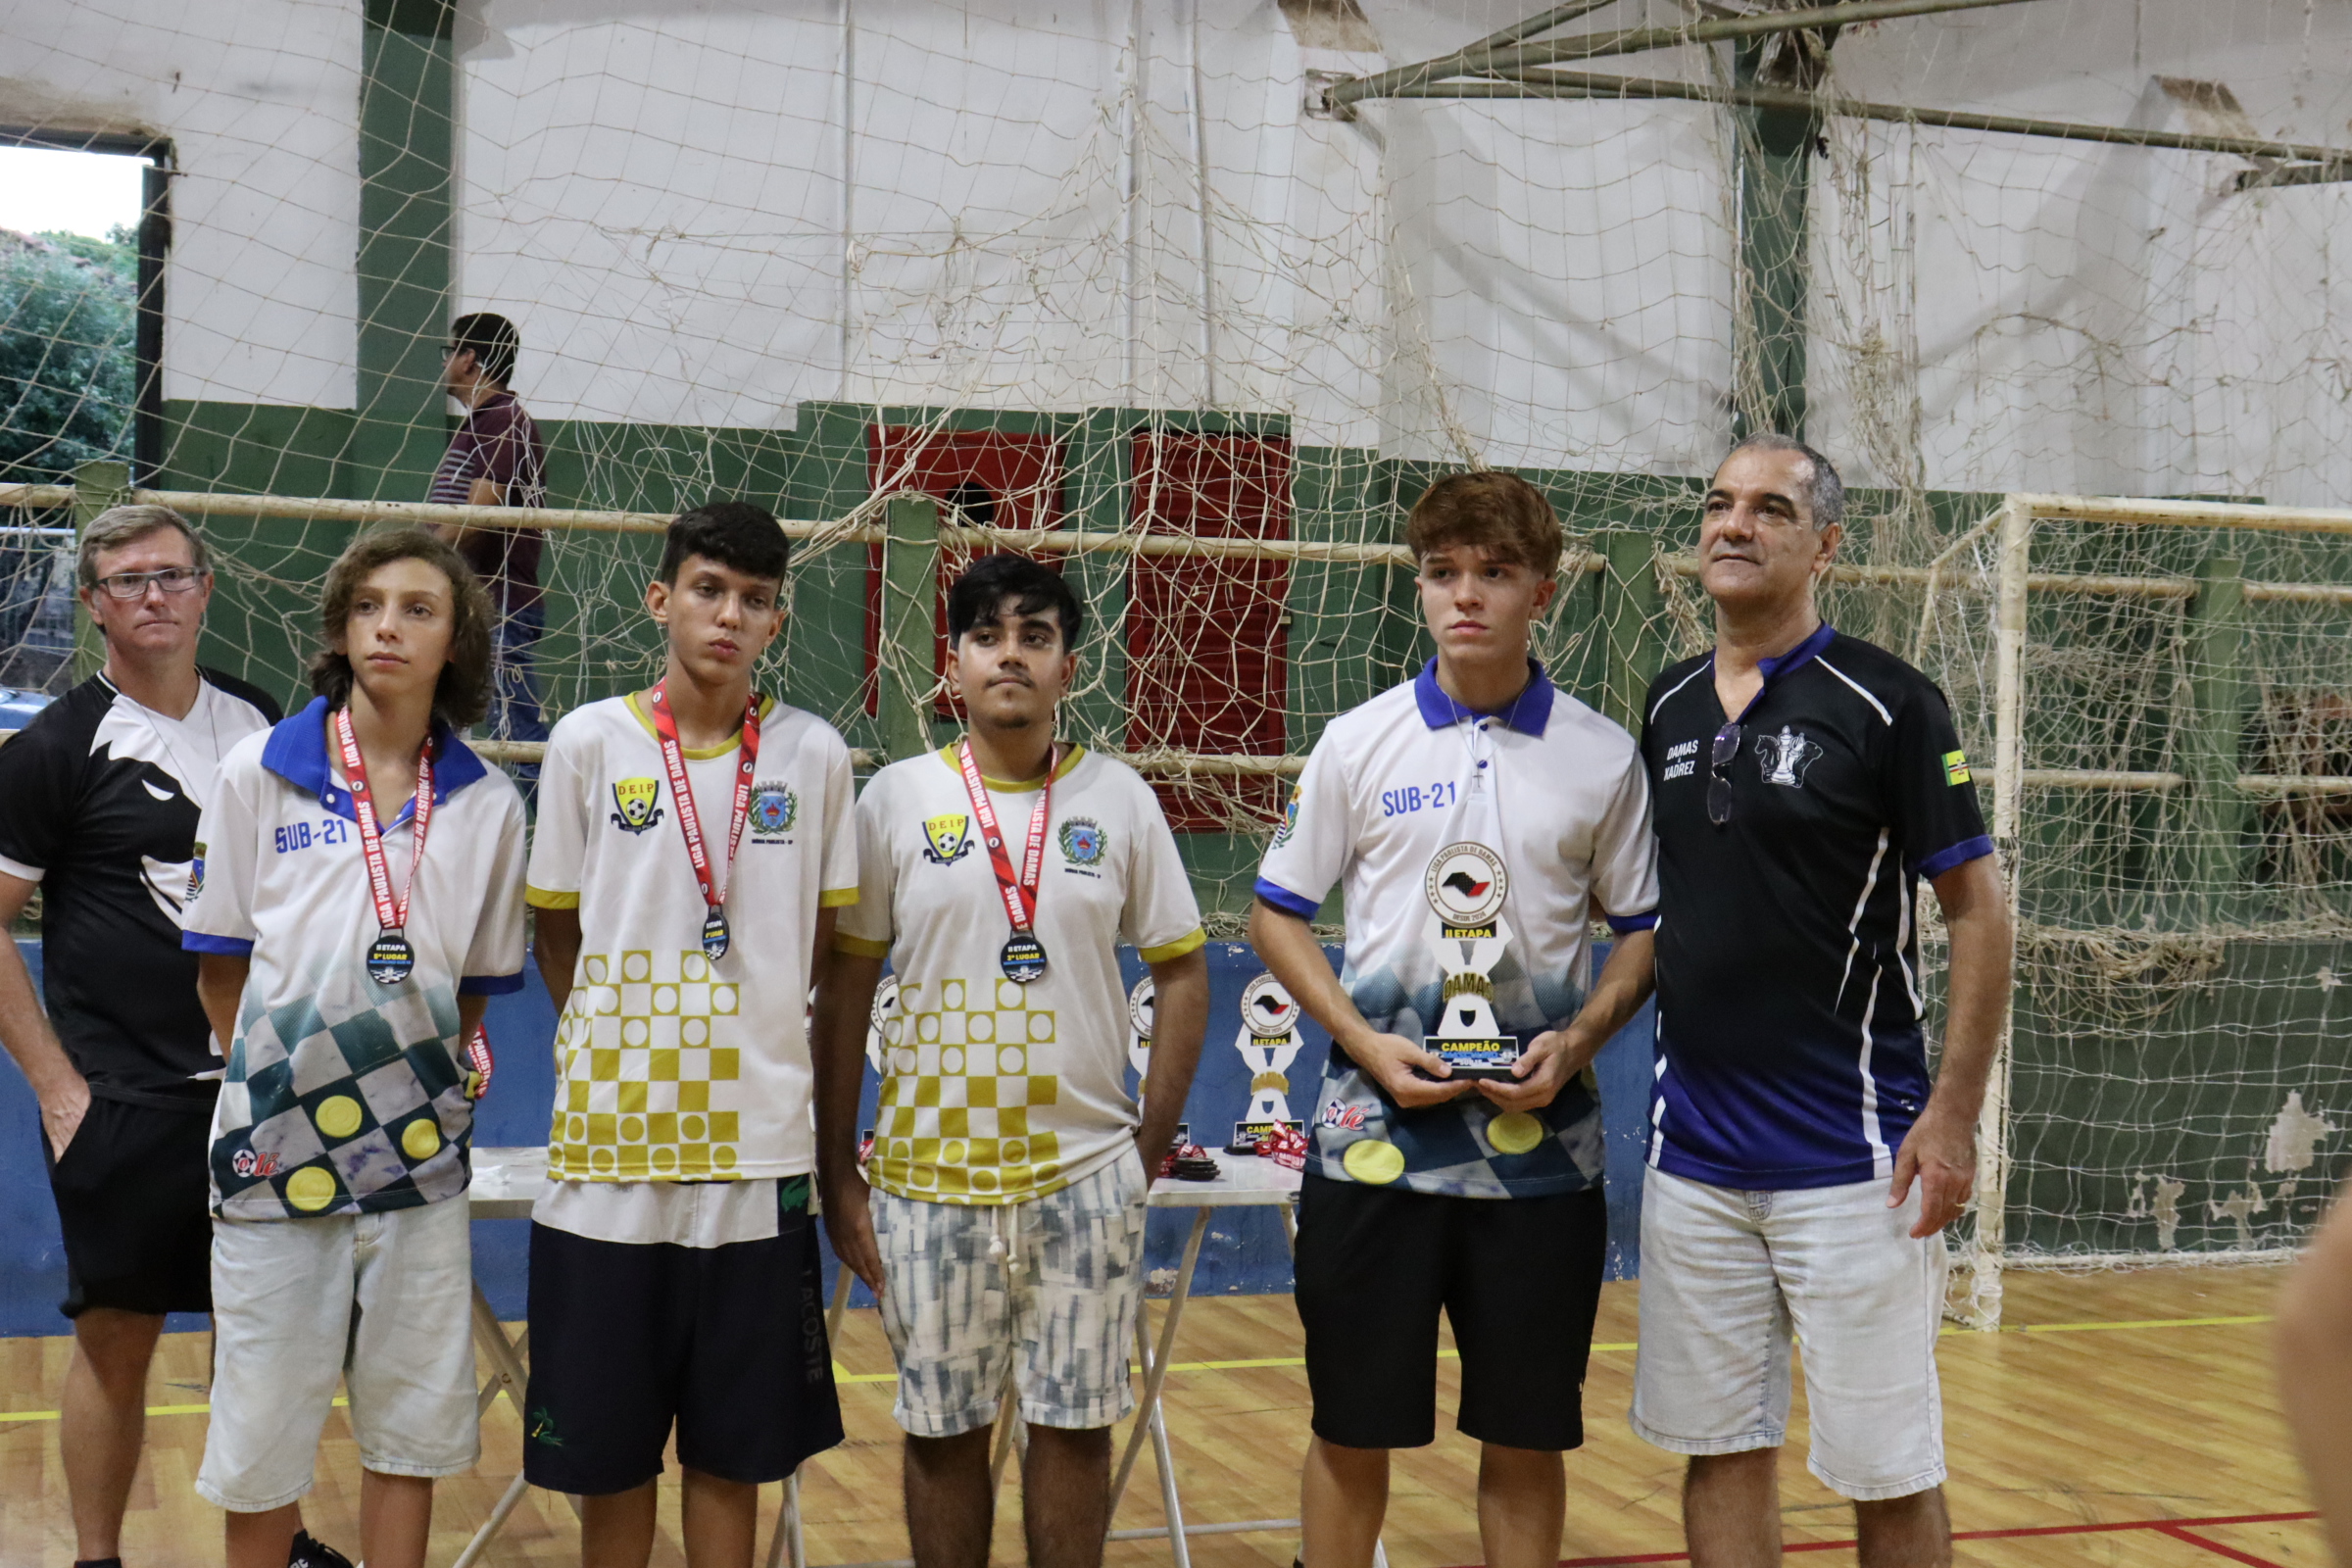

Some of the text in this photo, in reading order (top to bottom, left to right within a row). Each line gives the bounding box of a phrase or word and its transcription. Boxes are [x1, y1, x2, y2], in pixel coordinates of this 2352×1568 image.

[344, 743, 361, 767] LIGA
[1667, 739, 1698, 760] DAMAS
[418, 756, 429, 778] LIGA
[961, 754, 974, 769] DE
[1663, 760, 1695, 782] XADREZ
[618, 783, 654, 795] DEIP
[735, 783, 749, 808] LIGA
[964, 765, 988, 808] PAULISTA
[416, 777, 429, 823] PAULISTA
[663, 740, 706, 868] LIGA PAULISTA DE DAMAS
[1382, 780, 1455, 817] SUB-21
[929, 818, 964, 831] DEIP
[978, 806, 996, 829] LIGA
[275, 818, 347, 855] SUB-21
[415, 822, 426, 838] DE
[1028, 834, 1041, 848] DE
[357, 801, 396, 929] LIGA PAULISTA DE DAMAS
[1023, 849, 1040, 887] DAMAS
[1431, 858, 1443, 872] LIGA
[1441, 846, 1469, 861] PAULISTA
[1478, 849, 1498, 867] DAMAS
[1005, 885, 1027, 923] DAMAS
[1471, 910, 1487, 920] 2024
[1446, 929, 1493, 938] II ETAPA
[1443, 971, 1494, 1004] DAMAS
[1259, 1038, 1288, 1047] ETAPA
[1442, 1040, 1500, 1052] CAMPEÃO
